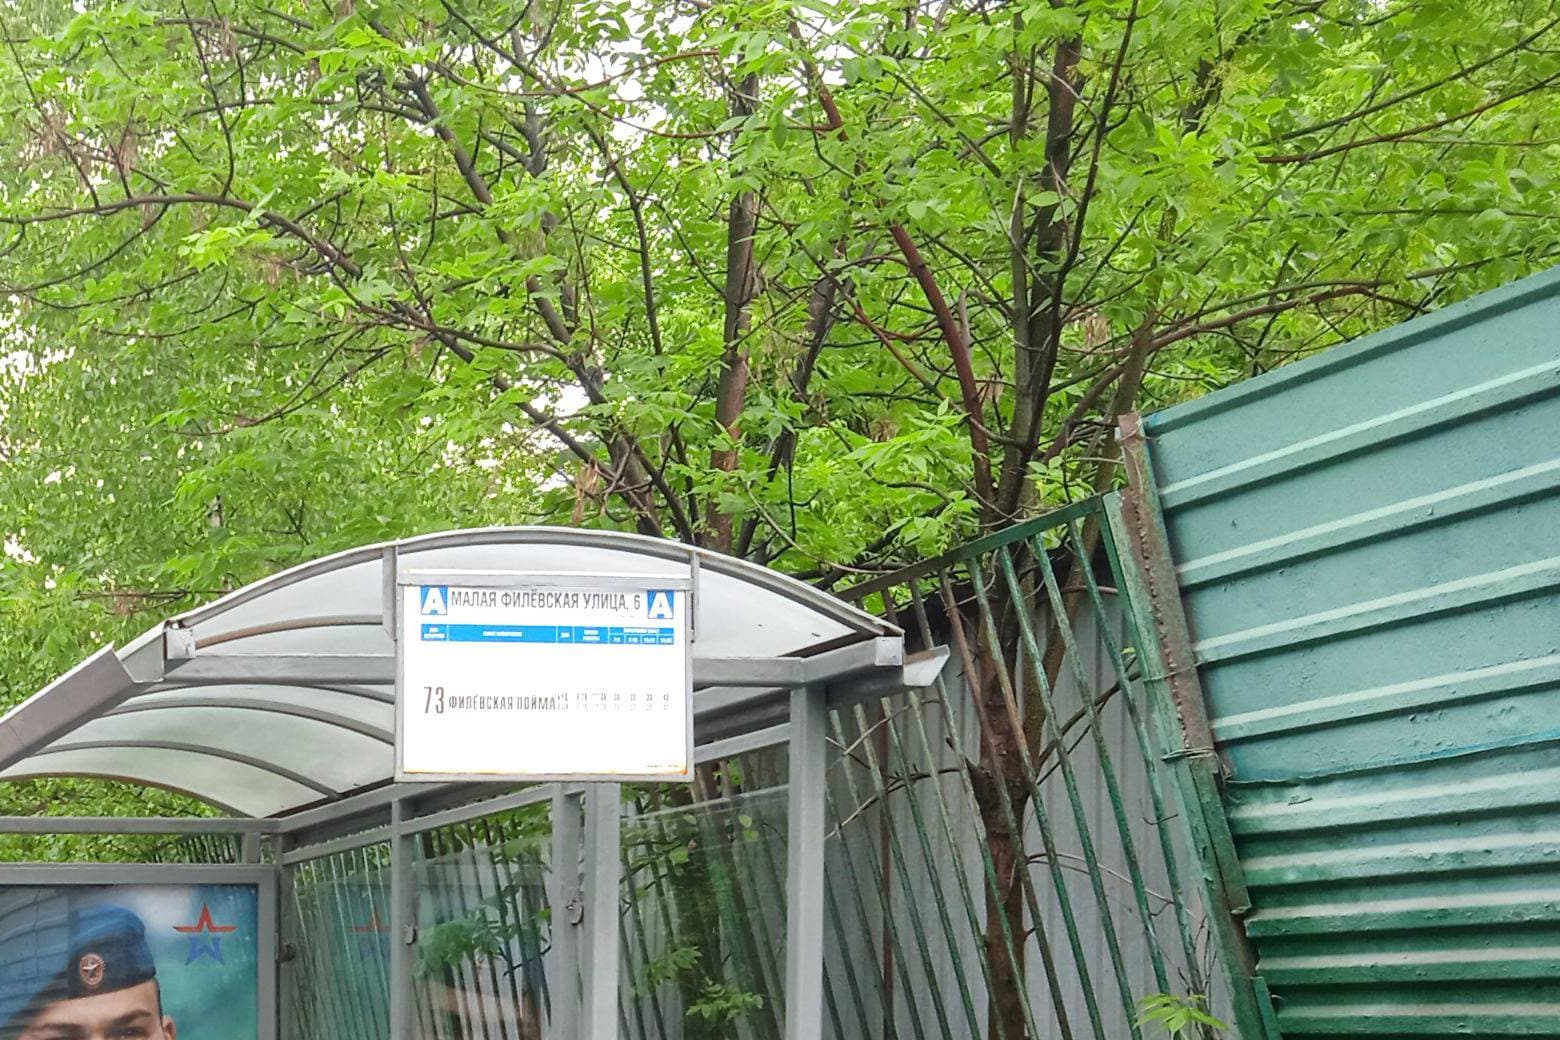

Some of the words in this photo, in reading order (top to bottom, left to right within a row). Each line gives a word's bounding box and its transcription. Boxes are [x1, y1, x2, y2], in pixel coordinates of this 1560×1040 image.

[451, 590, 497, 608] МАЛАЯ
[501, 589, 579, 609] ФИЛЁВСКАЯ
[633, 594, 641, 610] 6
[423, 686, 445, 714] 73
[517, 694, 556, 710] ПОЙМА
